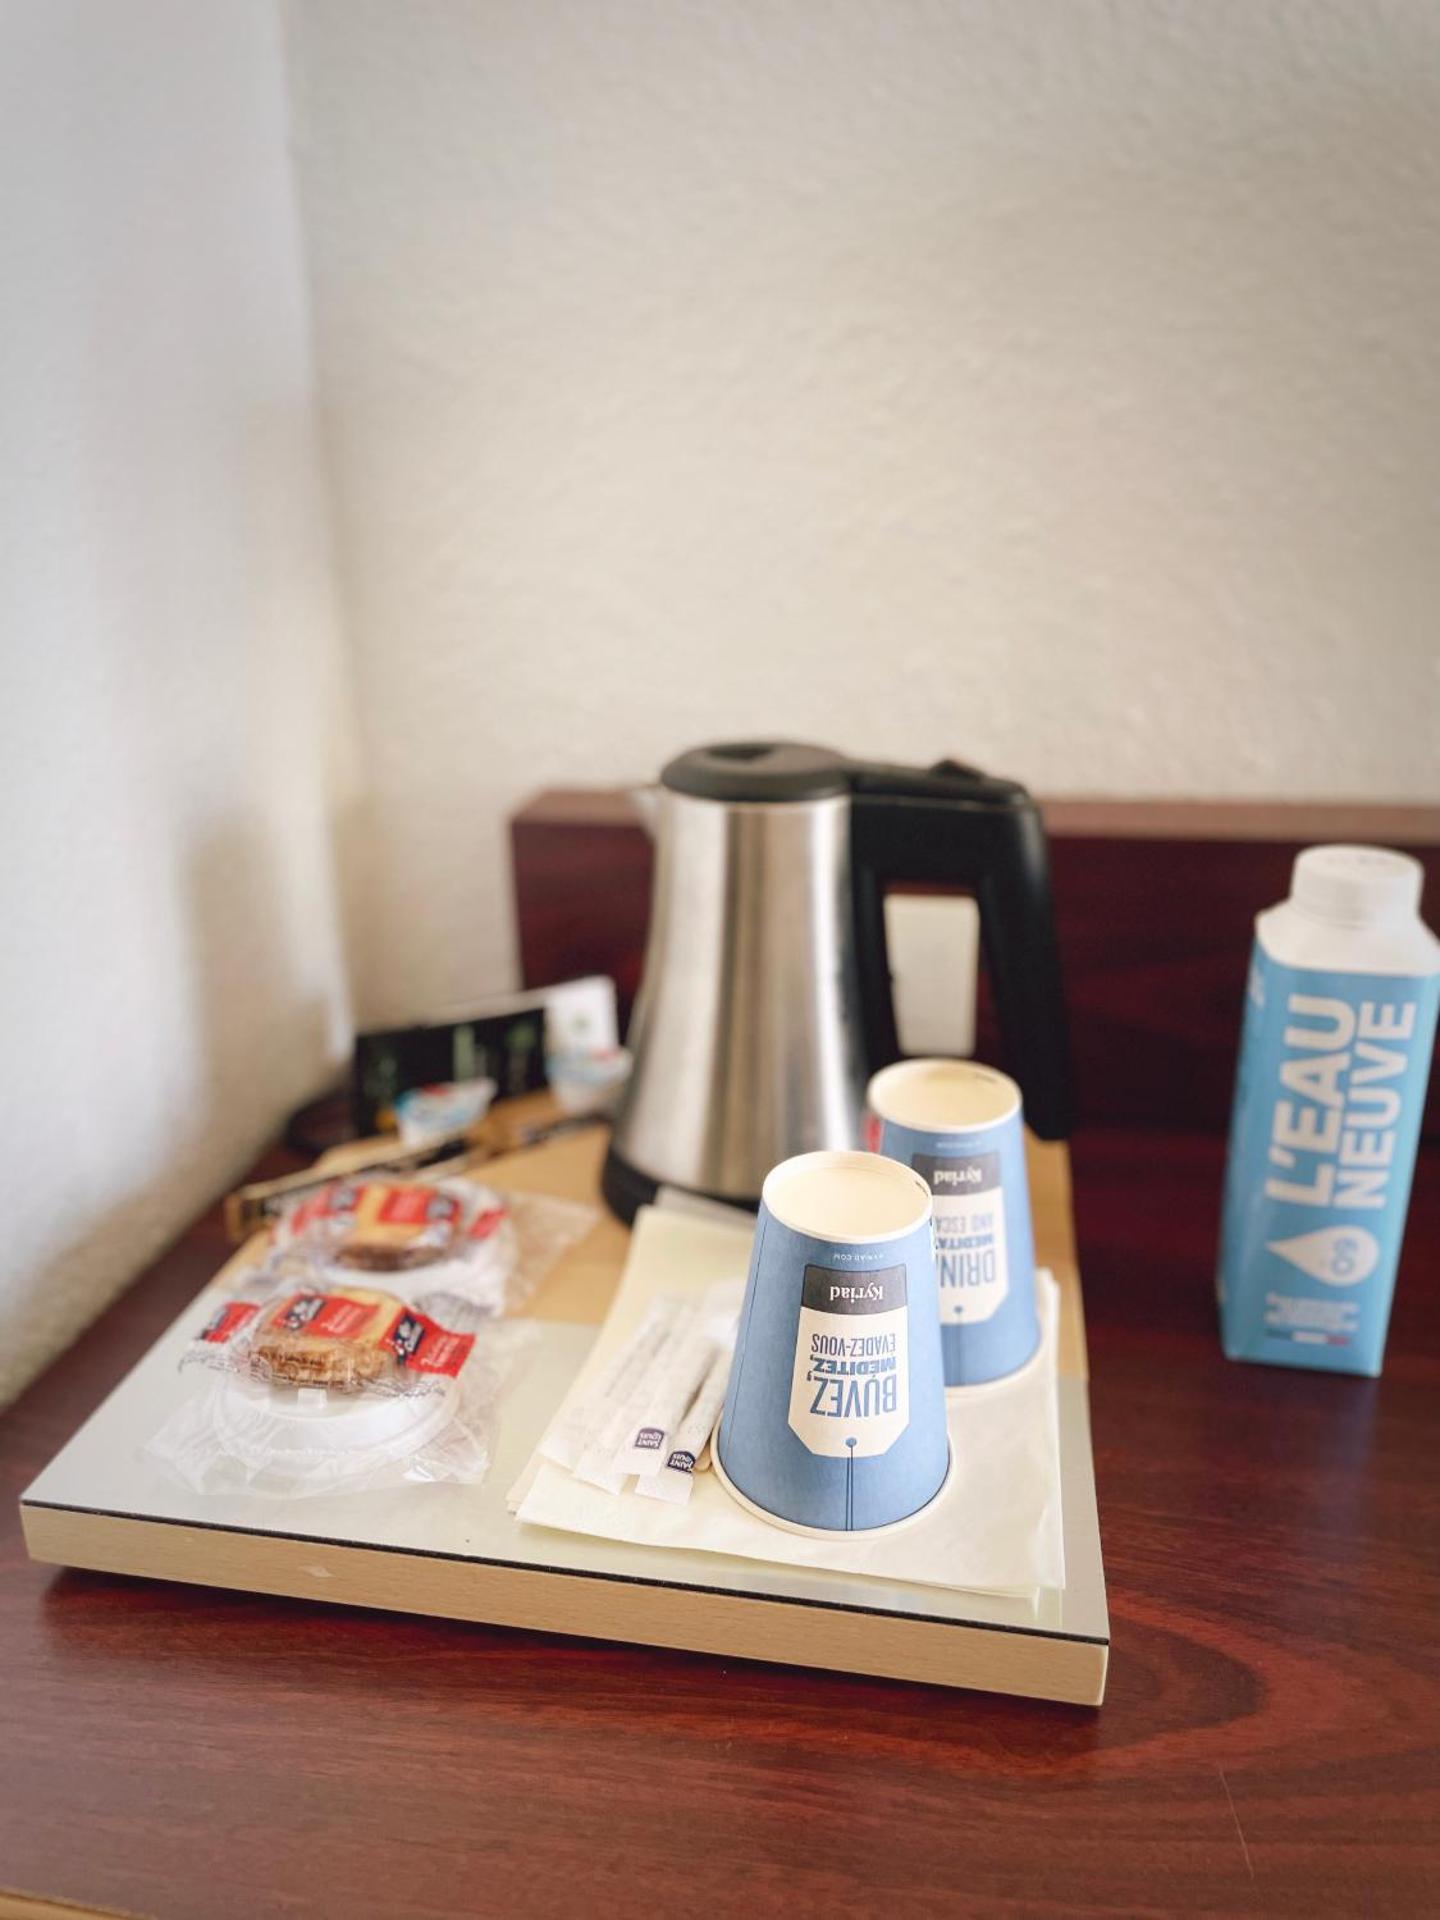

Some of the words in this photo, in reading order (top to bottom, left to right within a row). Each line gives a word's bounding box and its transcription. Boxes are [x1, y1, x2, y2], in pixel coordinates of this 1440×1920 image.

[1264, 993, 1356, 1208] L'EAU
[1332, 1001, 1417, 1210] NEUVE
[933, 1166, 982, 1185] Kyriad
[936, 1215, 967, 1234] ESCA
[936, 1233, 994, 1250] MEDITA
[936, 1250, 995, 1288] DRIN
[830, 1282, 884, 1303] Kyriad
[806, 1370, 897, 1418] BUVEZ,
